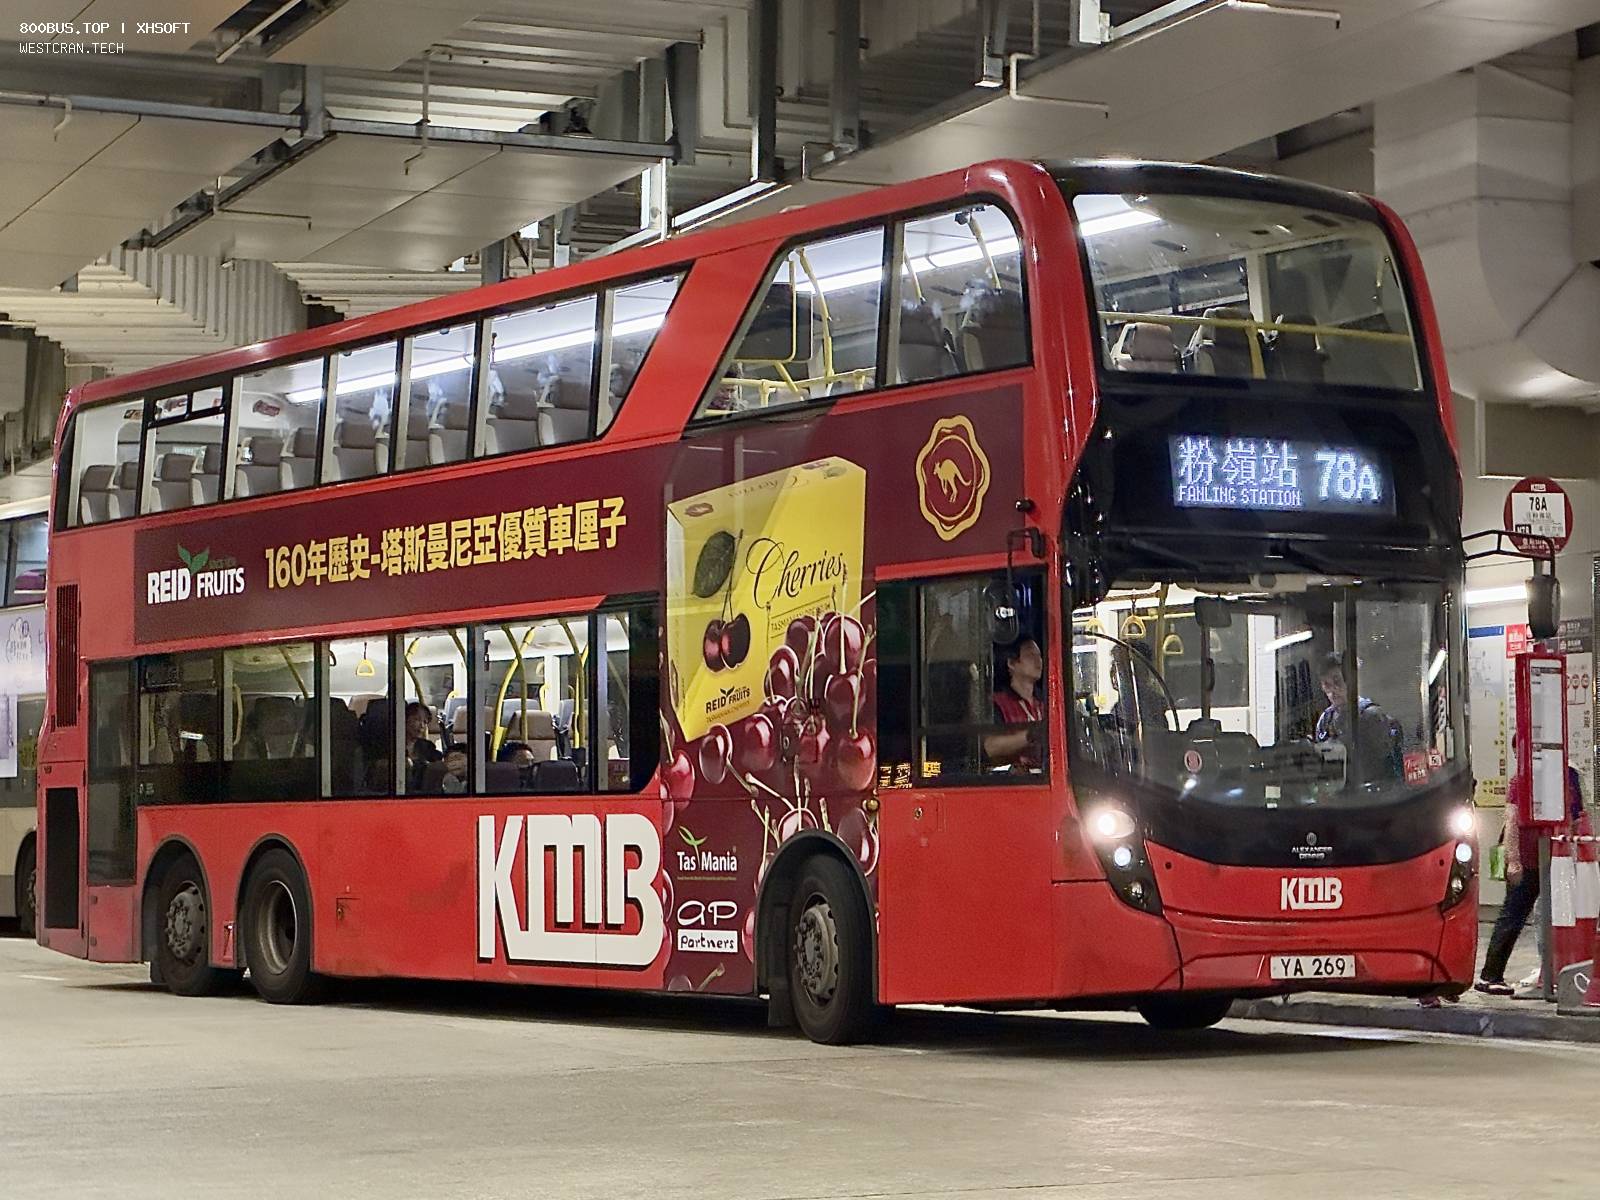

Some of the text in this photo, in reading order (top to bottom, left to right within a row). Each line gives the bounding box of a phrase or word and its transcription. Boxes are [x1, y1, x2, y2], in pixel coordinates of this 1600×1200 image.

[1178, 436, 1379, 501] 粉嶺站 78A
[1529, 497, 1547, 511] 78A
[147, 567, 245, 605] REID FRUITS
[746, 538, 845, 609] Cherries
[705, 696, 727, 714] REID
[729, 688, 750, 704] FRUITS
[677, 850, 738, 871] Tas Mania
[1280, 877, 1343, 911] KMB
[680, 932, 734, 949] Partners
[1280, 958, 1346, 977] YA 269
